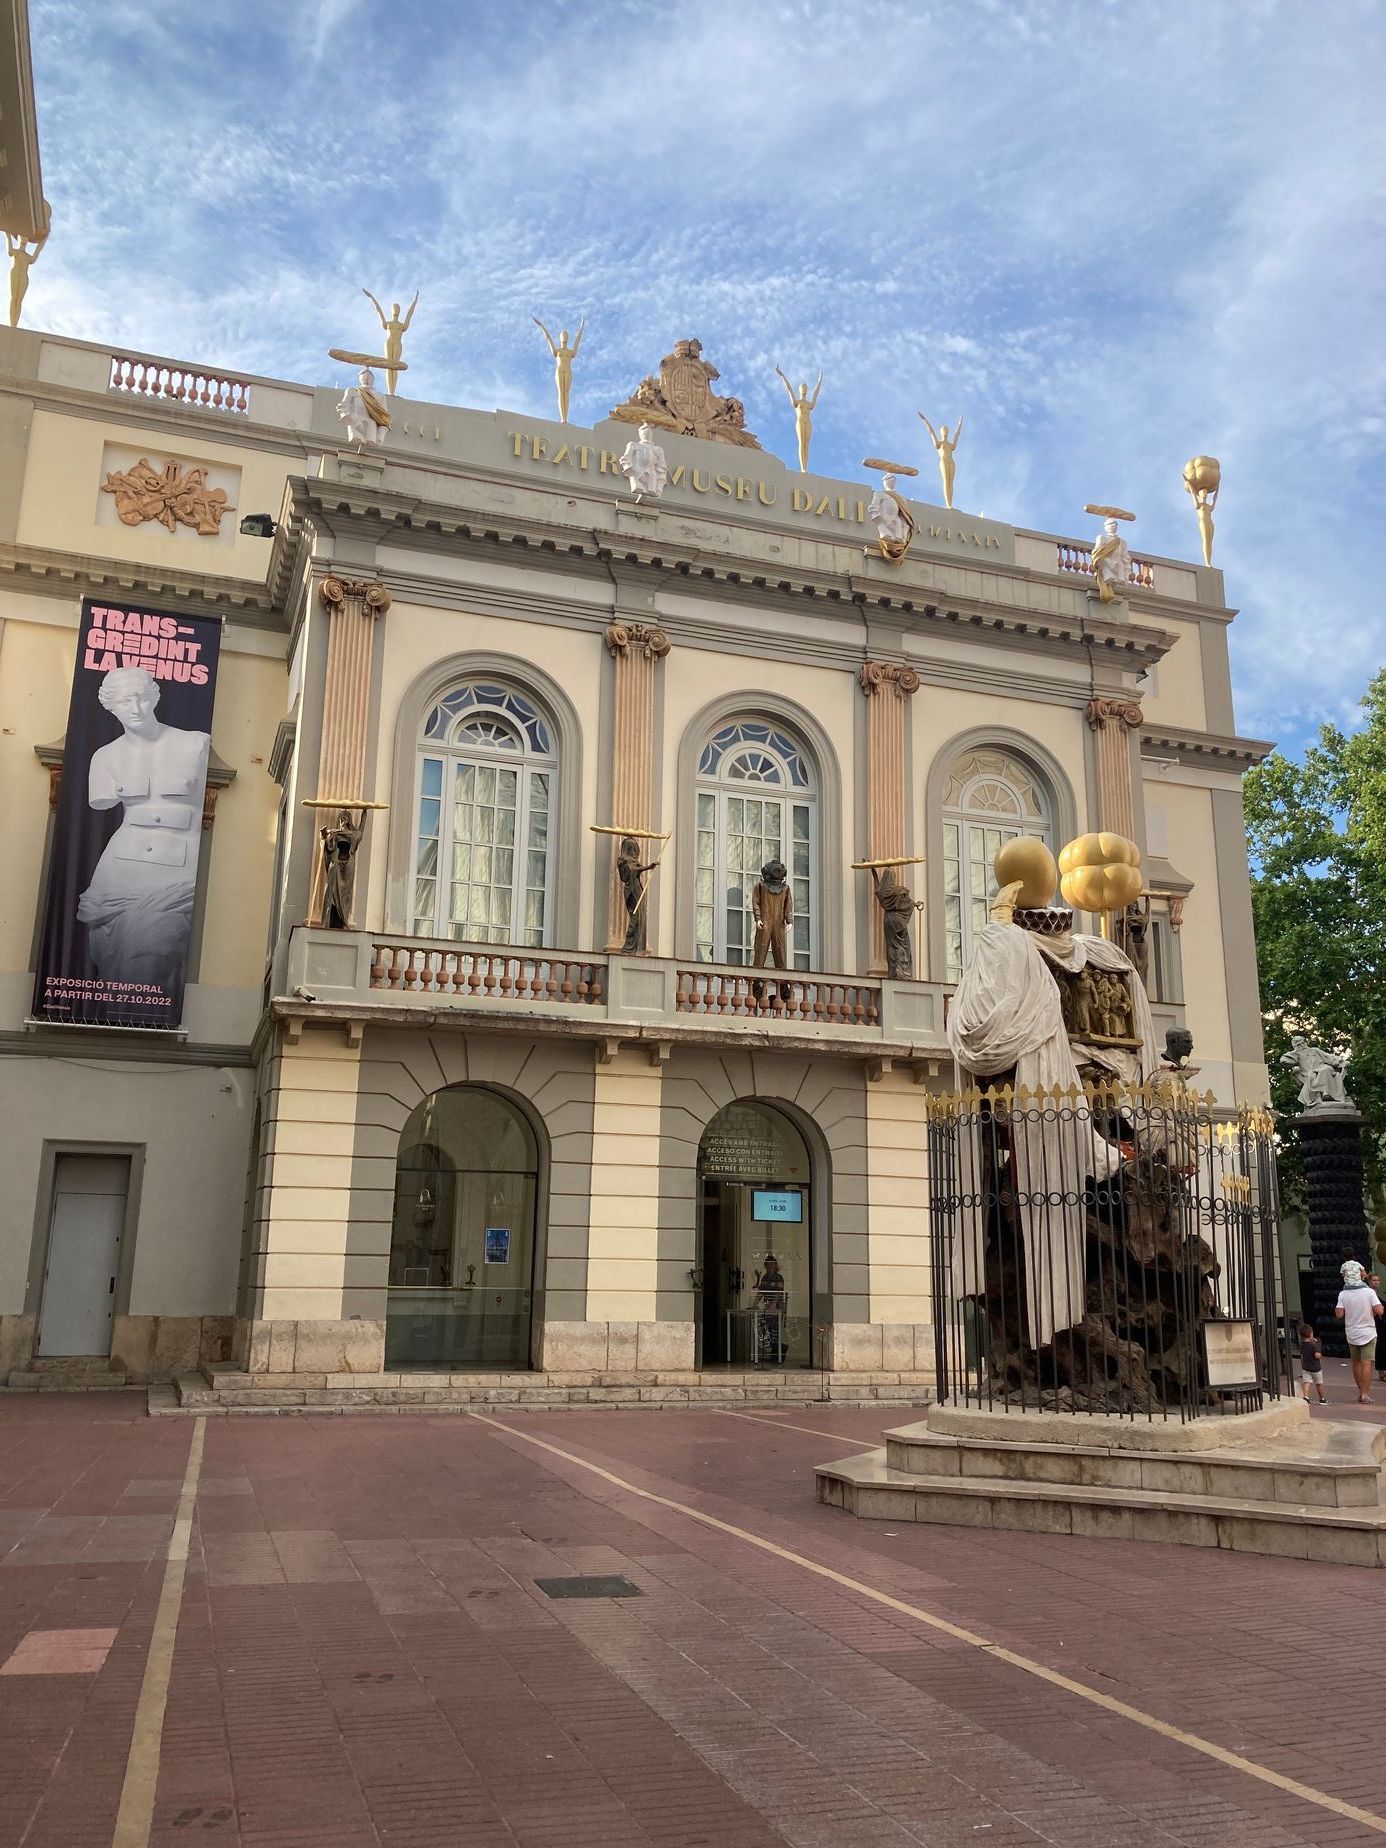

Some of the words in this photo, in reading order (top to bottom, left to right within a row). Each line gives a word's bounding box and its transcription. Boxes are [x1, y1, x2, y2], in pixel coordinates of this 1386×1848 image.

[507, 431, 621, 475] TEATR
[666, 464, 777, 505] MUSEU
[90, 606, 195, 638] TRANS-
[86, 627, 202, 663] GREDINT
[83, 648, 117, 672] LA
[121, 653, 209, 685] VENUS
[44, 988, 52, 997] A
[54, 989, 92, 1000] PARTIR
[94, 992, 115, 1002] DEL
[116, 994, 172, 1006] 27.10.2022
[46, 976, 104, 989] EXPOSICIÓ
[106, 981, 163, 994] TEMPORAL
[707, 1147, 735, 1155] ACCESO
